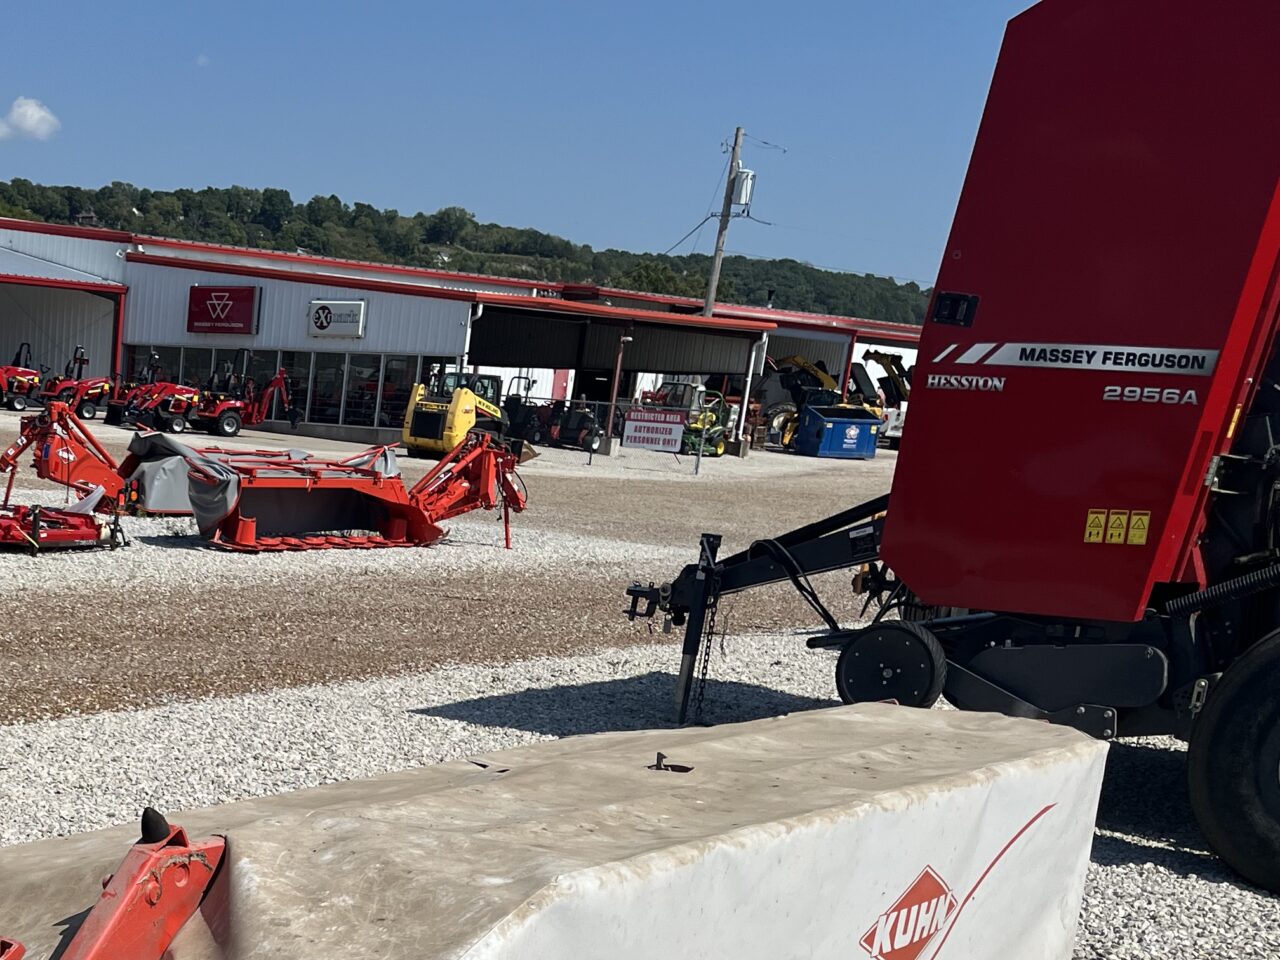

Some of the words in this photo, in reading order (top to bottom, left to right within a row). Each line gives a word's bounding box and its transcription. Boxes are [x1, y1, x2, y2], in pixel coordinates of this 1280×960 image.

[1019, 347, 1096, 365] MASSEY
[1102, 351, 1206, 370] FERGUSON
[926, 374, 1006, 391] HESSTON
[1102, 385, 1199, 405] 2956A
[631, 412, 665, 421] RESTRICTED
[666, 414, 681, 423] AREA
[634, 425, 673, 435] AUTHORIZED
[626, 435, 661, 445] PERSONNEL
[662, 438, 678, 447] ONLY
[870, 890, 953, 957] KUHN
